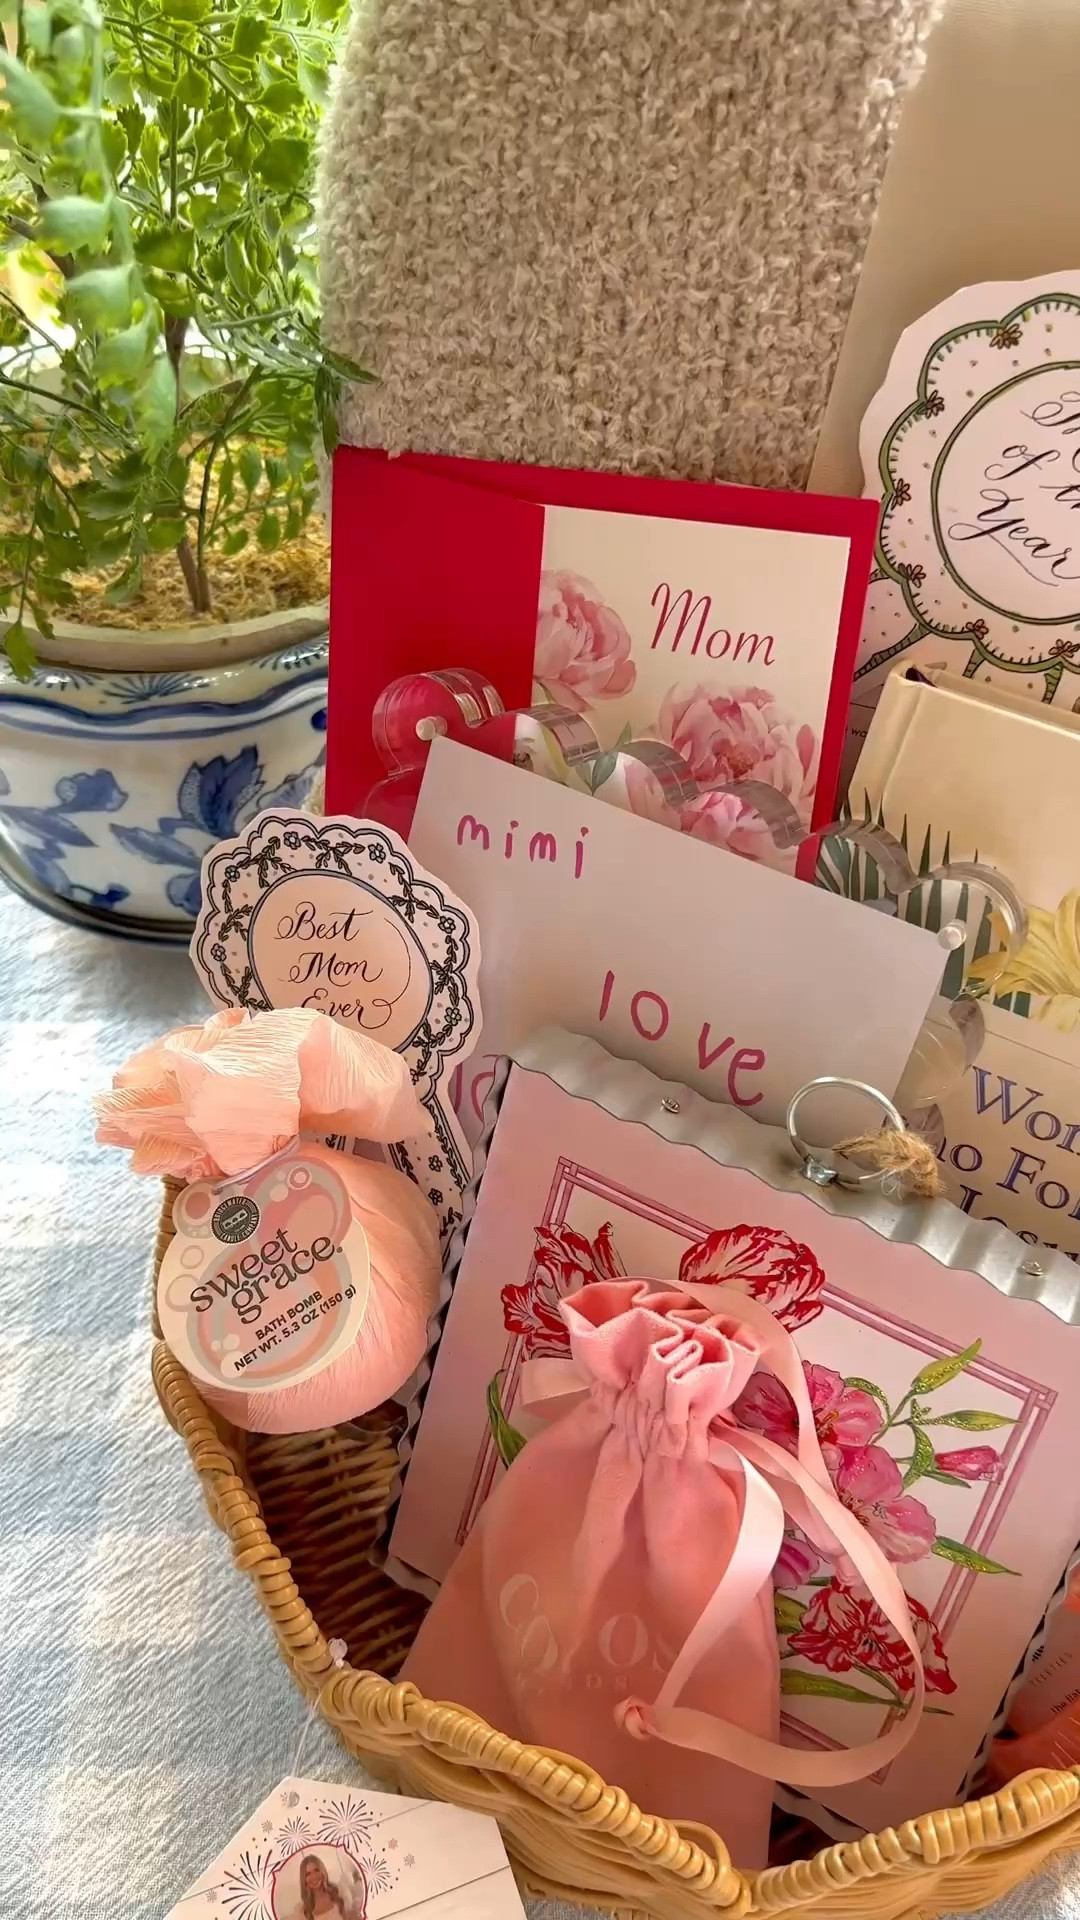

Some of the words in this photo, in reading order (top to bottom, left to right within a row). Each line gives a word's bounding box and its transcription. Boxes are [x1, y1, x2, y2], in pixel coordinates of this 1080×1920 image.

[984, 444, 1061, 480] of
[948, 488, 1080, 586] Year
[650, 582, 776, 666] Mom
[456, 814, 590, 879] mimi
[273, 901, 374, 941] Best
[287, 951, 384, 988] Mom
[599, 970, 766, 1106] love
[190, 1228, 298, 1313] sweet
[233, 1348, 258, 1371] NET
[259, 1335, 282, 1354] WT.
[281, 1321, 301, 1338] 5.3
[301, 1308, 320, 1325] OZ
[320, 1292, 343, 1314] (150
[344, 1284, 357, 1299] g)
[255, 1314, 287, 1340] BATH
[286, 1290, 323, 1319] BOMB
